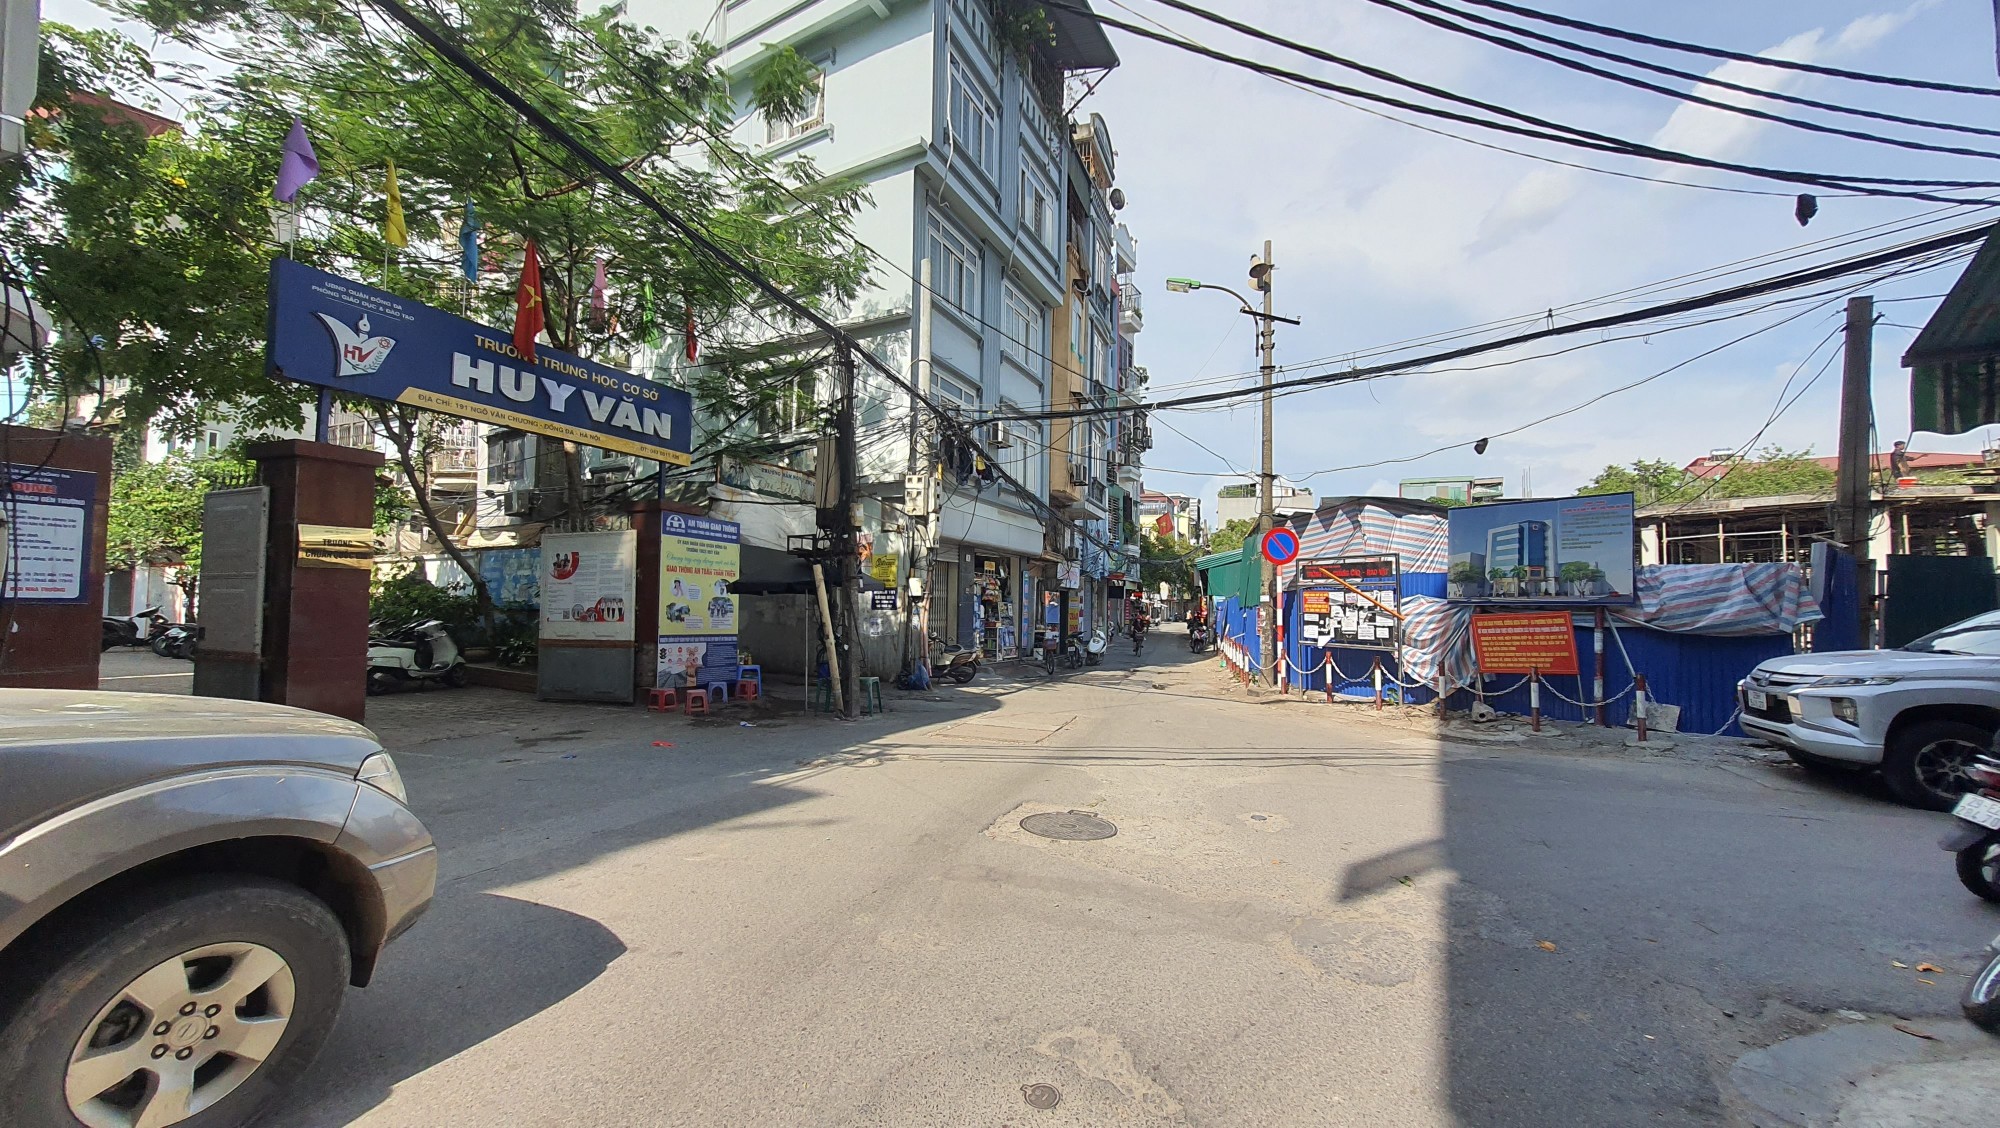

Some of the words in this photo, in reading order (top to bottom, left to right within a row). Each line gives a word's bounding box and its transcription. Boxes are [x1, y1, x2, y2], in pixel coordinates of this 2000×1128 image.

[324, 281, 347, 292] UBND
[542, 356, 588, 380] TRUNG
[592, 372, 618, 388] HỌC
[622, 382, 640, 395] CƠ
[642, 387, 659, 401] SỞ
[418, 394, 433, 402] ĐỊA
[452, 351, 577, 412] HUY
[582, 389, 672, 440] VĂN
[696, 520, 710, 530] TOÀN
[710, 523, 722, 531] GIAO
